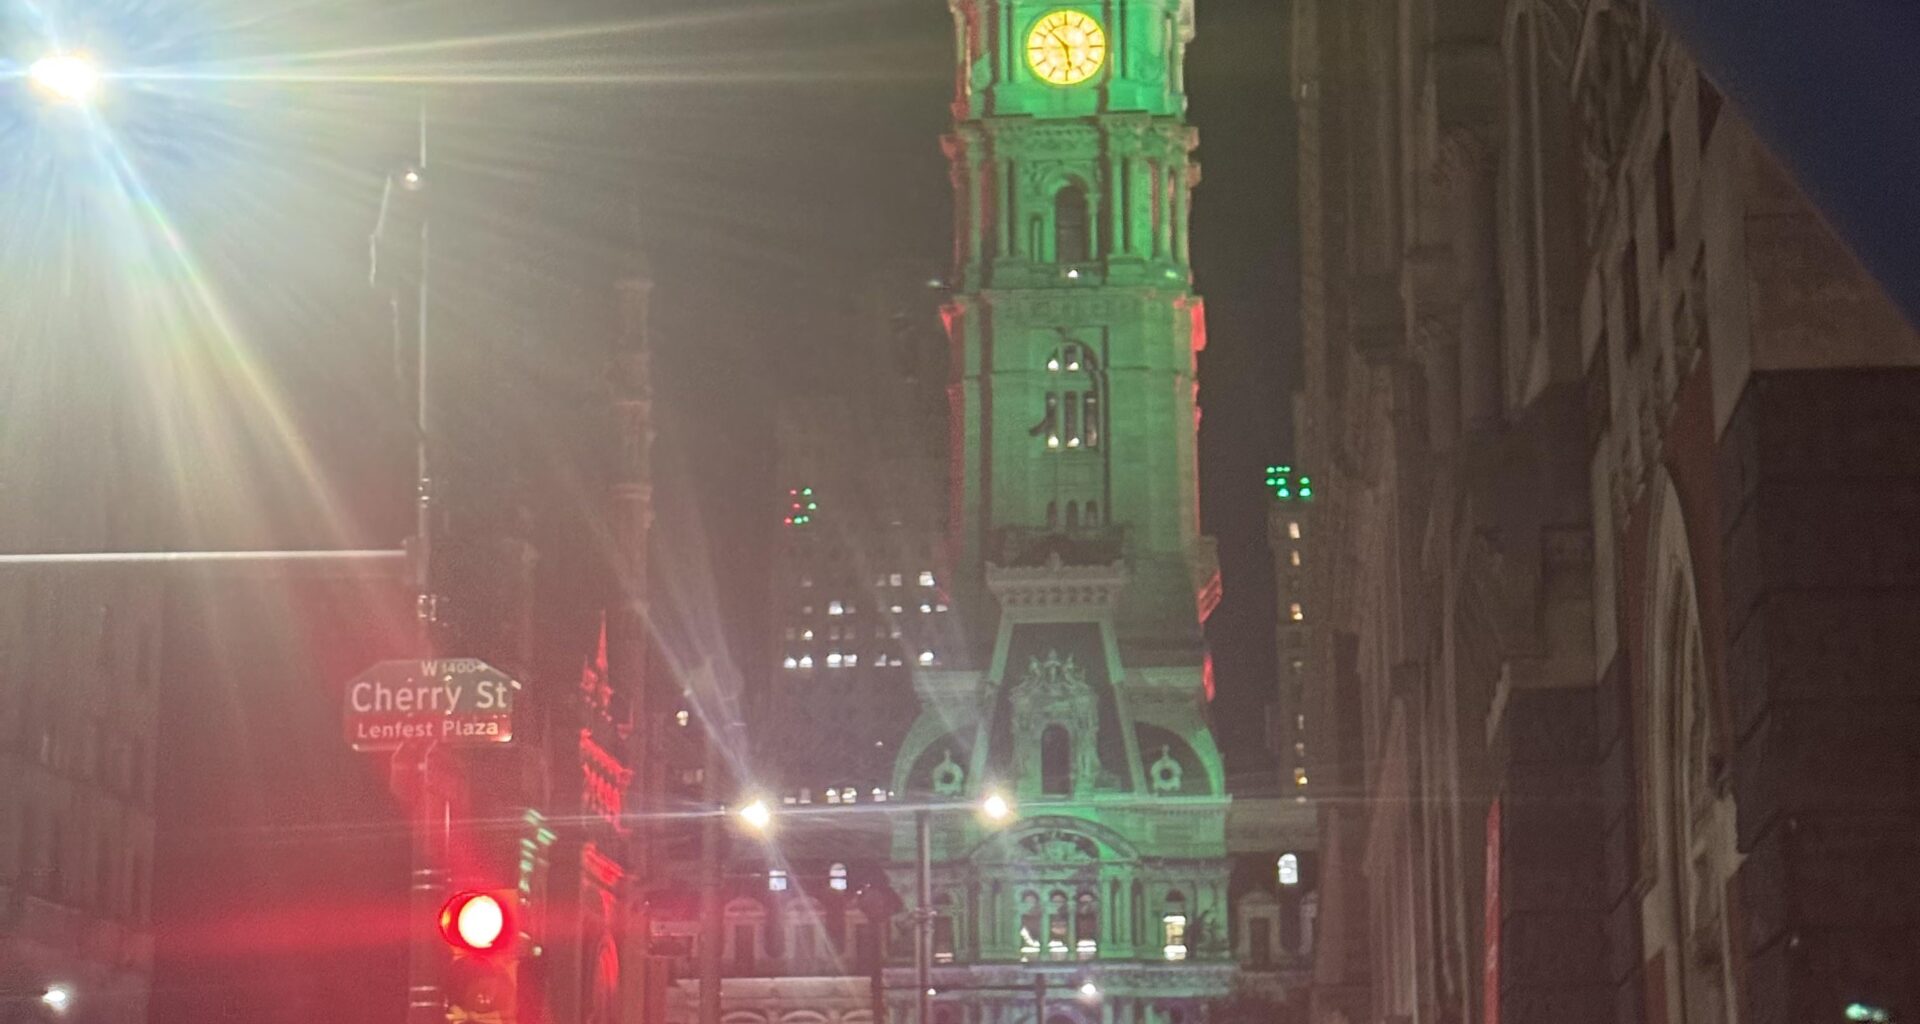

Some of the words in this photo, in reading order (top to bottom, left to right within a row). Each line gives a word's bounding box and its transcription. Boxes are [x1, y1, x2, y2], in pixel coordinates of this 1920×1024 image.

[421, 660, 438, 676] W
[352, 681, 462, 713] Cherry
[476, 681, 507, 708] St
[357, 721, 433, 738] Lenfest
[443, 720, 499, 736] Plaza
